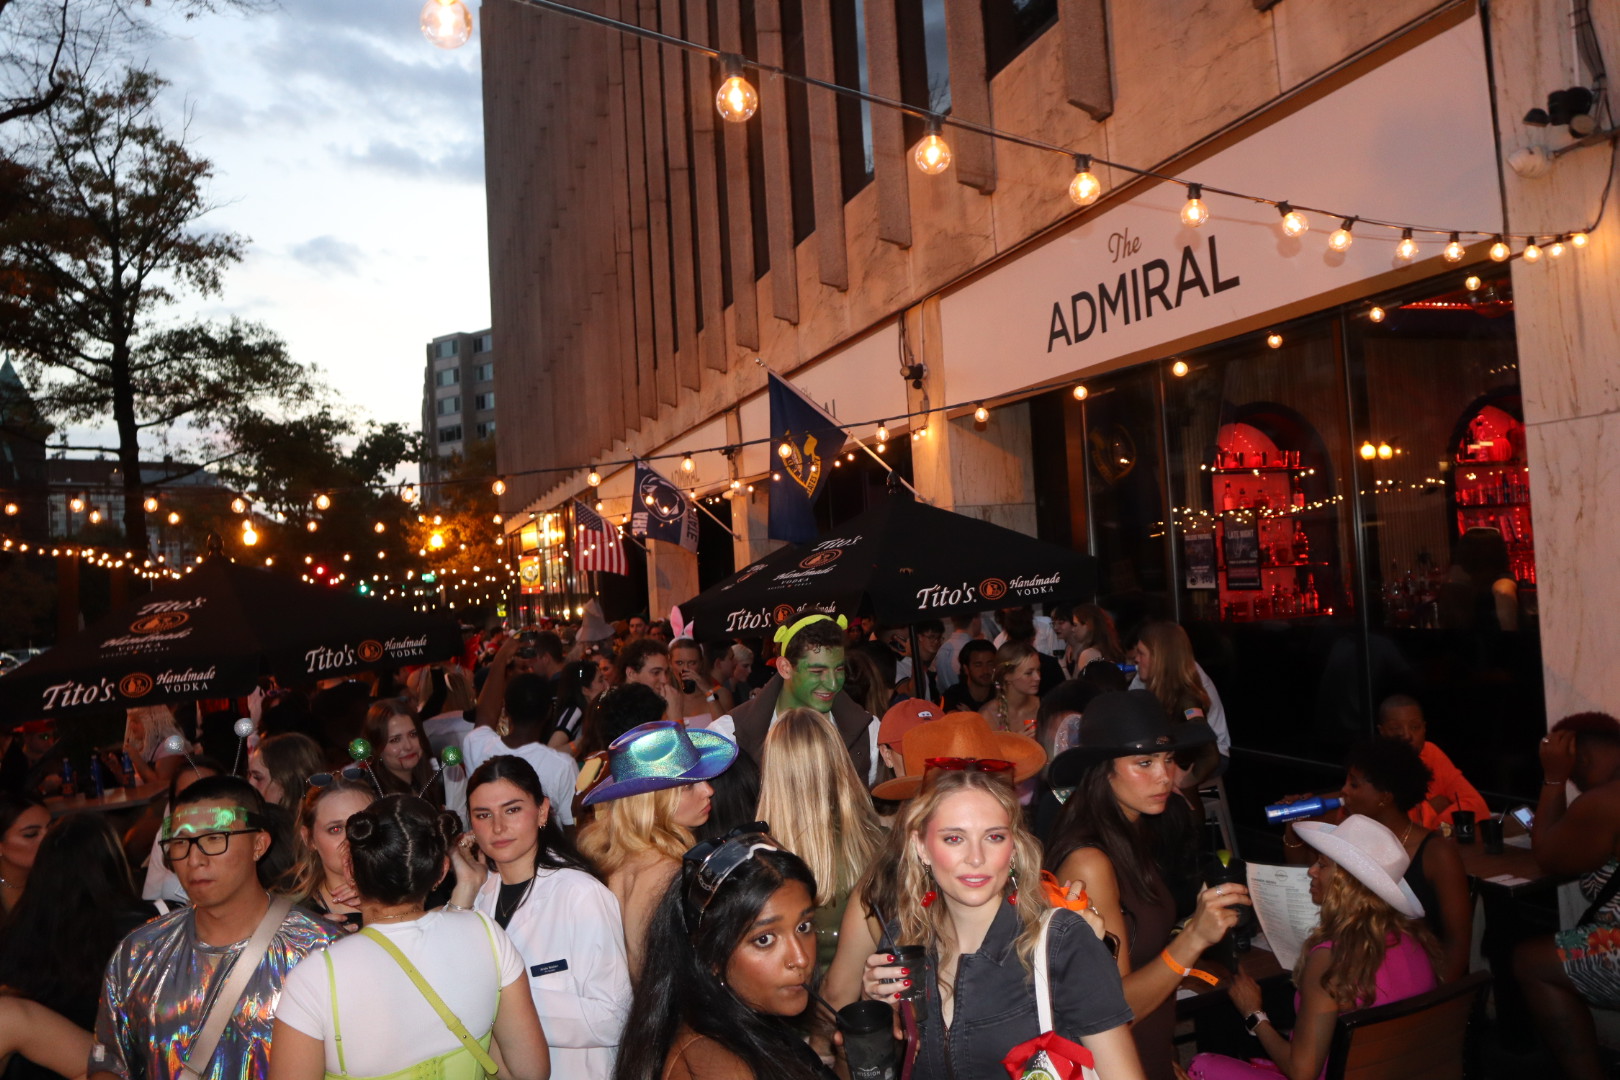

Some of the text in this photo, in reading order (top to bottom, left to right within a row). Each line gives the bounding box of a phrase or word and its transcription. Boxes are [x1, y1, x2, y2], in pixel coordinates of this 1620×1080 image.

[1108, 227, 1142, 263] The
[1047, 234, 1240, 353] ADMIRAL
[1009, 572, 1061, 589] Handmade
[1016, 585, 1054, 596] VODKA
[384, 634, 427, 651] Handmade
[390, 647, 424, 658] VODKA
[156, 666, 216, 685] Handmade
[164, 682, 208, 694] VODKA
